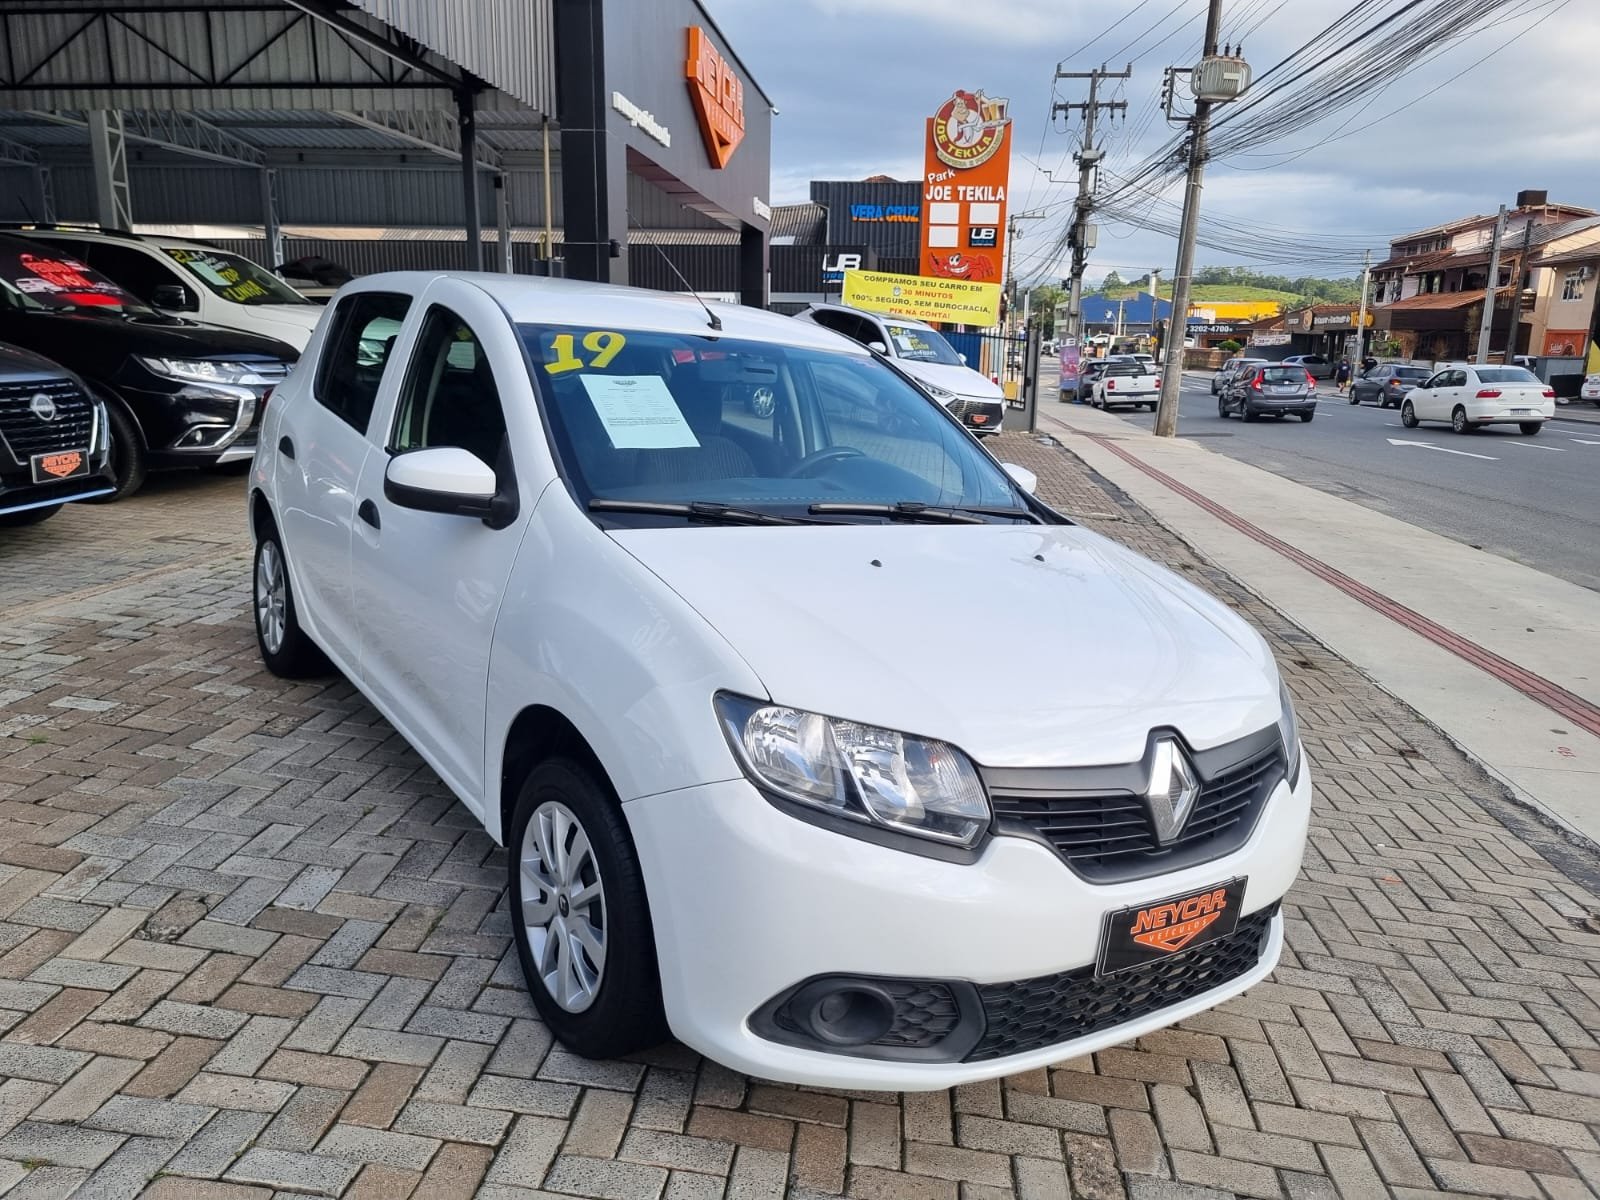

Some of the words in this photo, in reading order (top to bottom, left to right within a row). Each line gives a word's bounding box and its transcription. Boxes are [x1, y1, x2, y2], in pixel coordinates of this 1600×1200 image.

[688, 26, 745, 131] NEYCAR
[936, 118, 948, 144] JOE
[947, 135, 992, 158] TEKILA
[927, 168, 956, 184] Park
[925, 185, 952, 201] JOE
[957, 185, 1005, 201] TEKILA
[850, 204, 884, 222] VERA
[885, 205, 920, 223] CRUZ
[971, 228, 996, 239] UB
[822, 253, 861, 272] UB
[864, 275, 918, 286] COMPRAMOS
[920, 280, 936, 288] SEU
[939, 282, 967, 291] CARRO
[851, 294, 872, 302] 100%
[875, 296, 912, 306] SEGURO,
[934, 302, 991, 314] BUROCRACIA,
[914, 290, 953, 299] MINUTOS
[919, 310, 951, 319] CONTA!
[544, 331, 627, 374] 19
[1130, 888, 1227, 934] NEYCAR
